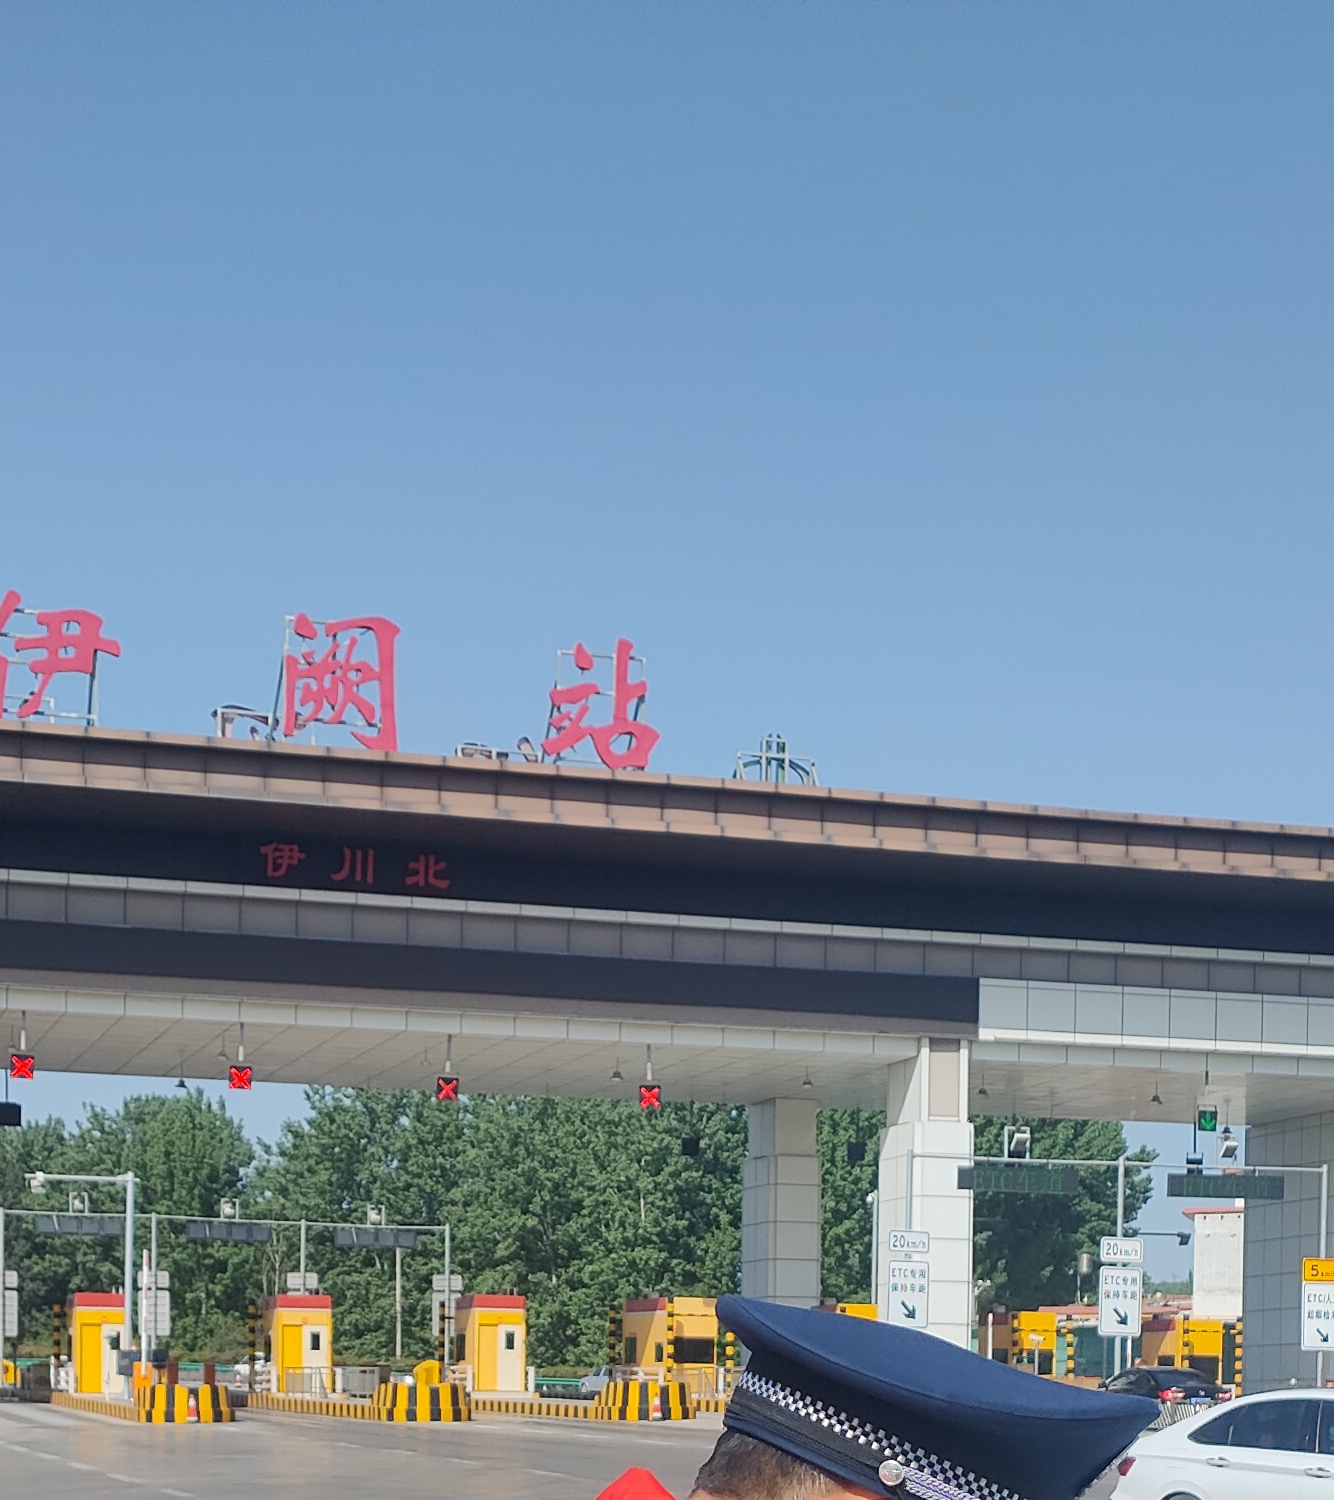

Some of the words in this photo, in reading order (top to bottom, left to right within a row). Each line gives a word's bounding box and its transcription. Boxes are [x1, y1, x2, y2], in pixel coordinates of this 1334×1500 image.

[259, 842, 451, 890] 伊川北
[1105, 1242, 1139, 1257] 20km/h
